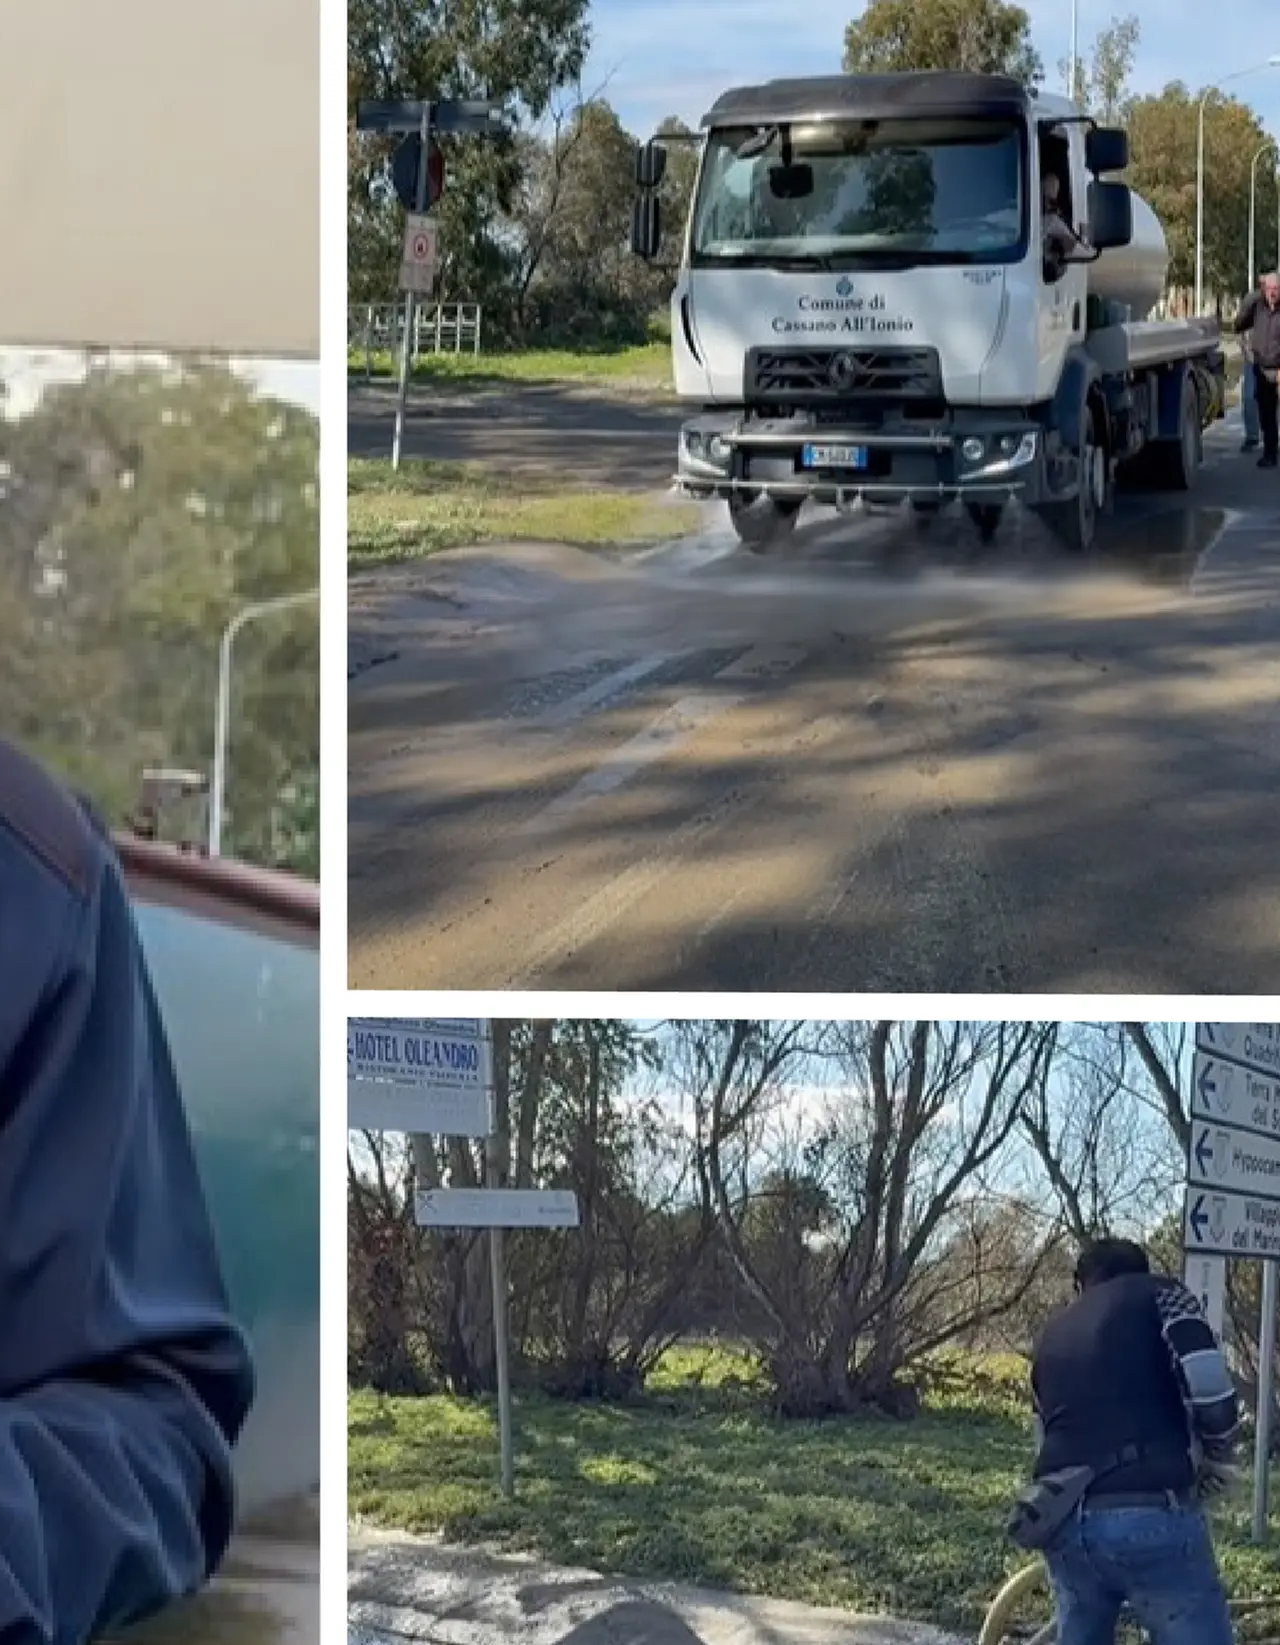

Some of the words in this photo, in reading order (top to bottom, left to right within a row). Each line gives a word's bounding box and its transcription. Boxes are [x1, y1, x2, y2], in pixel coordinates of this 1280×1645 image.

[798, 294, 863, 311] Comune
[868, 293, 886, 311] di
[772, 316, 836, 332] Cassano
[355, 1032, 401, 1064] HOTEL
[404, 1037, 480, 1072] OLEANDRO
[1246, 1072, 1270, 1103] Terra
[1231, 1226, 1248, 1249] del
